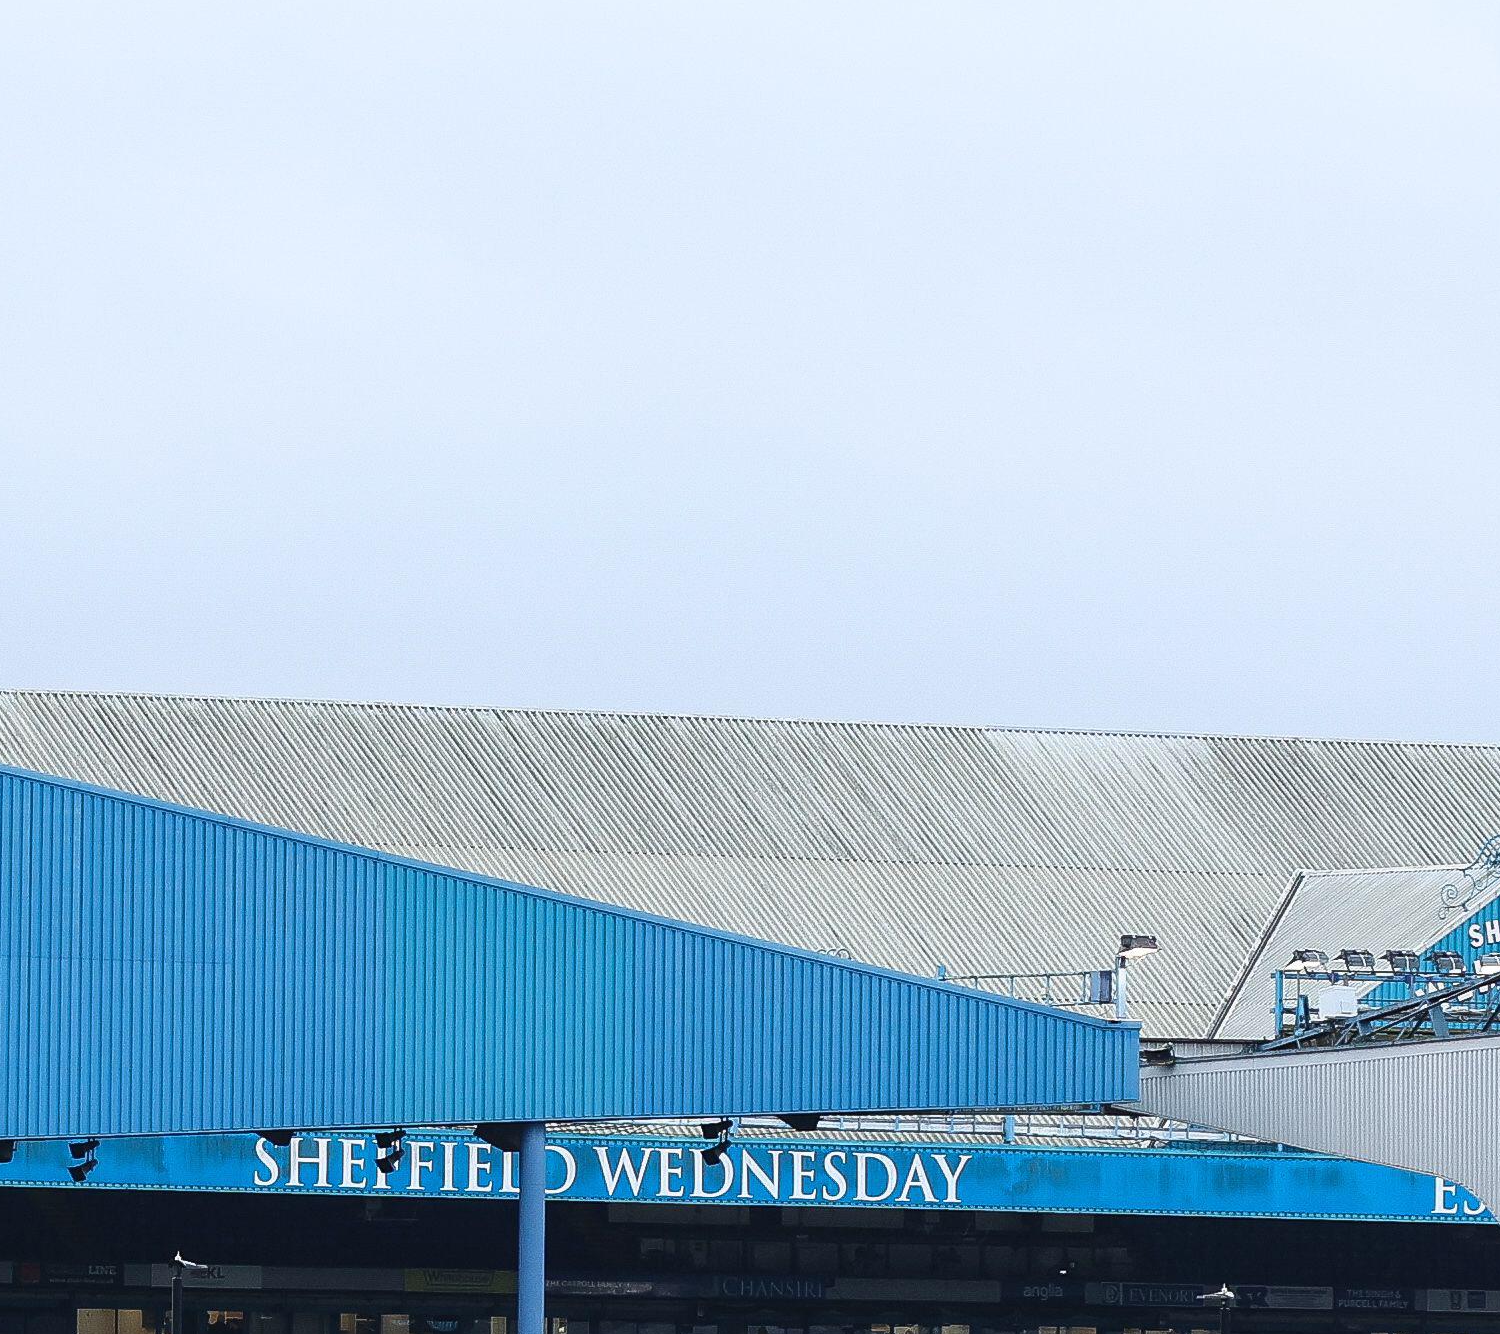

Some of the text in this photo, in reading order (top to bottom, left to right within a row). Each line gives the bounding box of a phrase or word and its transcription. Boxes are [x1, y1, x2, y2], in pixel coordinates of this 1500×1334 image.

[593, 1146, 973, 1204] WEDNESDAY
[722, 1279, 823, 1298] CHANSIRI
[1023, 1283, 1064, 1301] anglia
